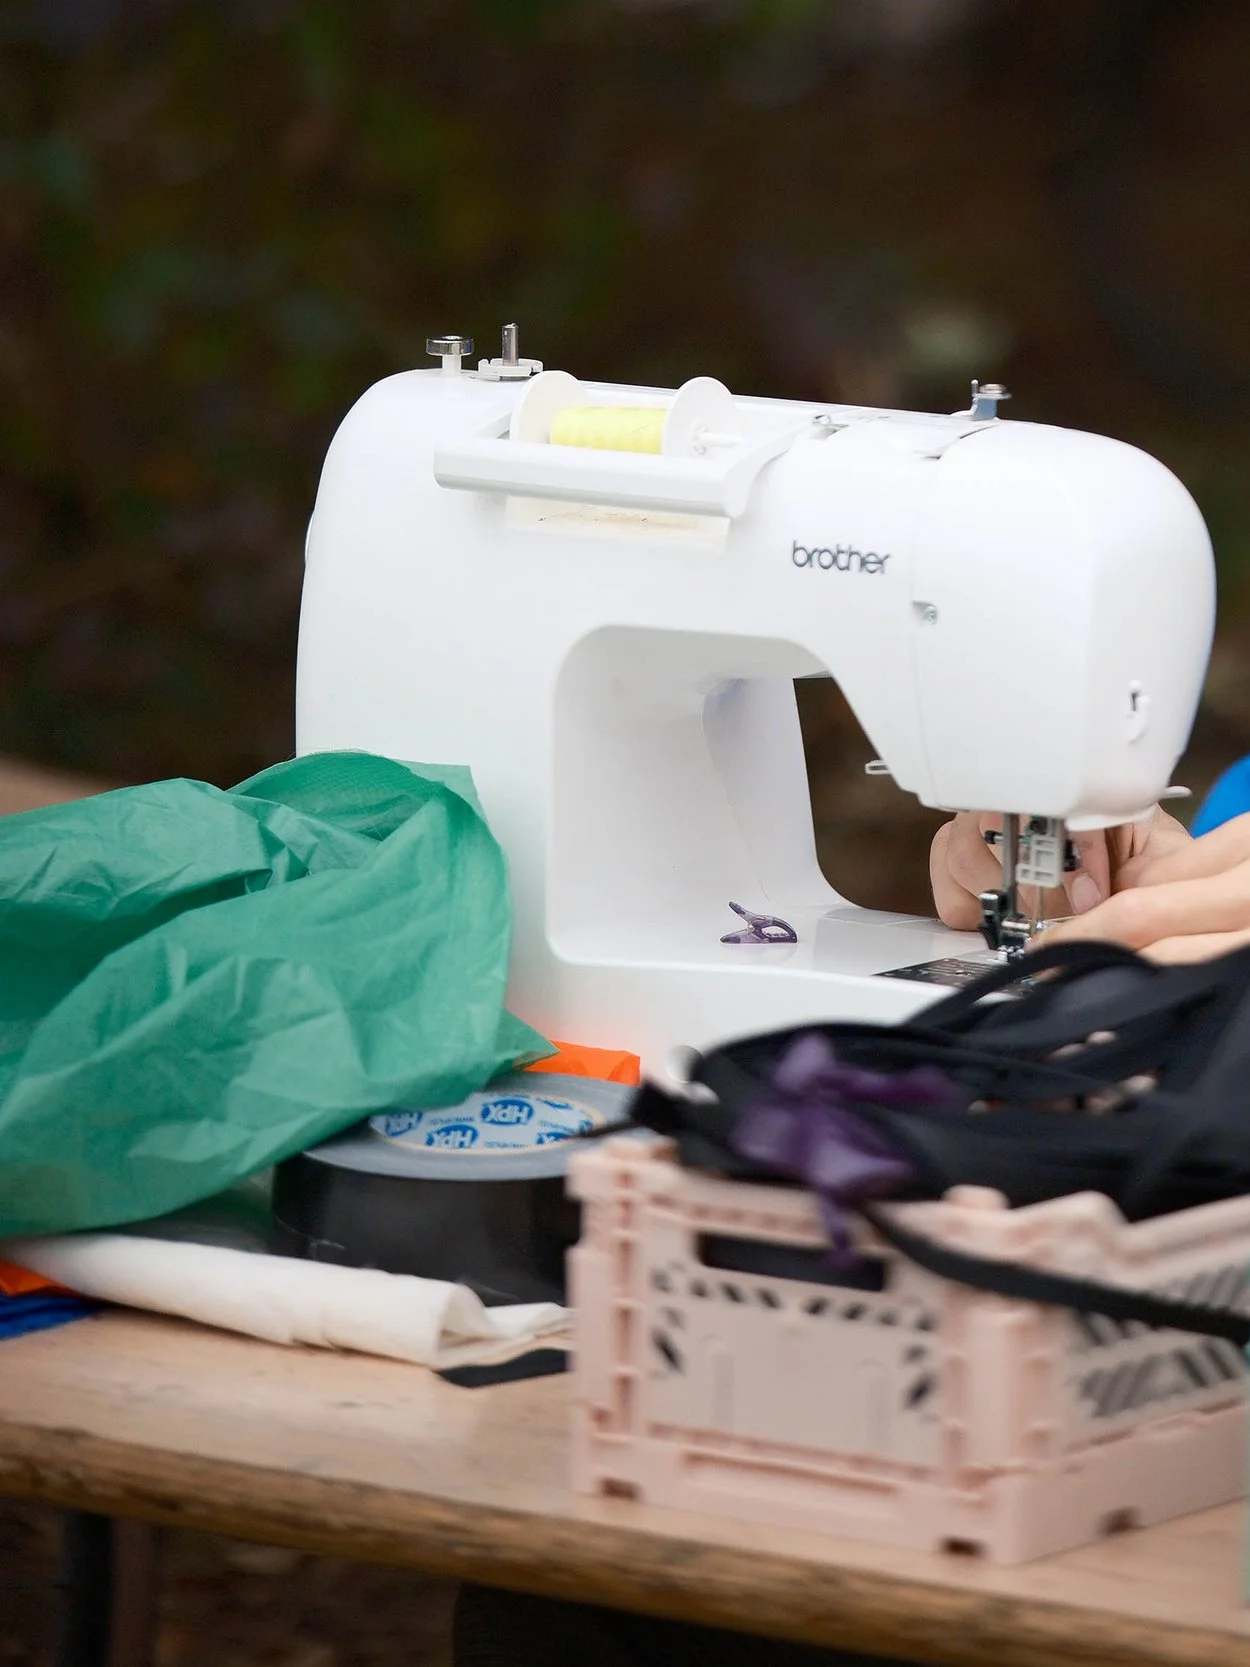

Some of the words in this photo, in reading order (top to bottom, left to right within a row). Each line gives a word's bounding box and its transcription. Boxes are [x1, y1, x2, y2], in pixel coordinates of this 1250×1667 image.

[792, 540, 891, 574] brother
[485, 1103, 530, 1124] HPX
[431, 1130, 474, 1148] HPX
